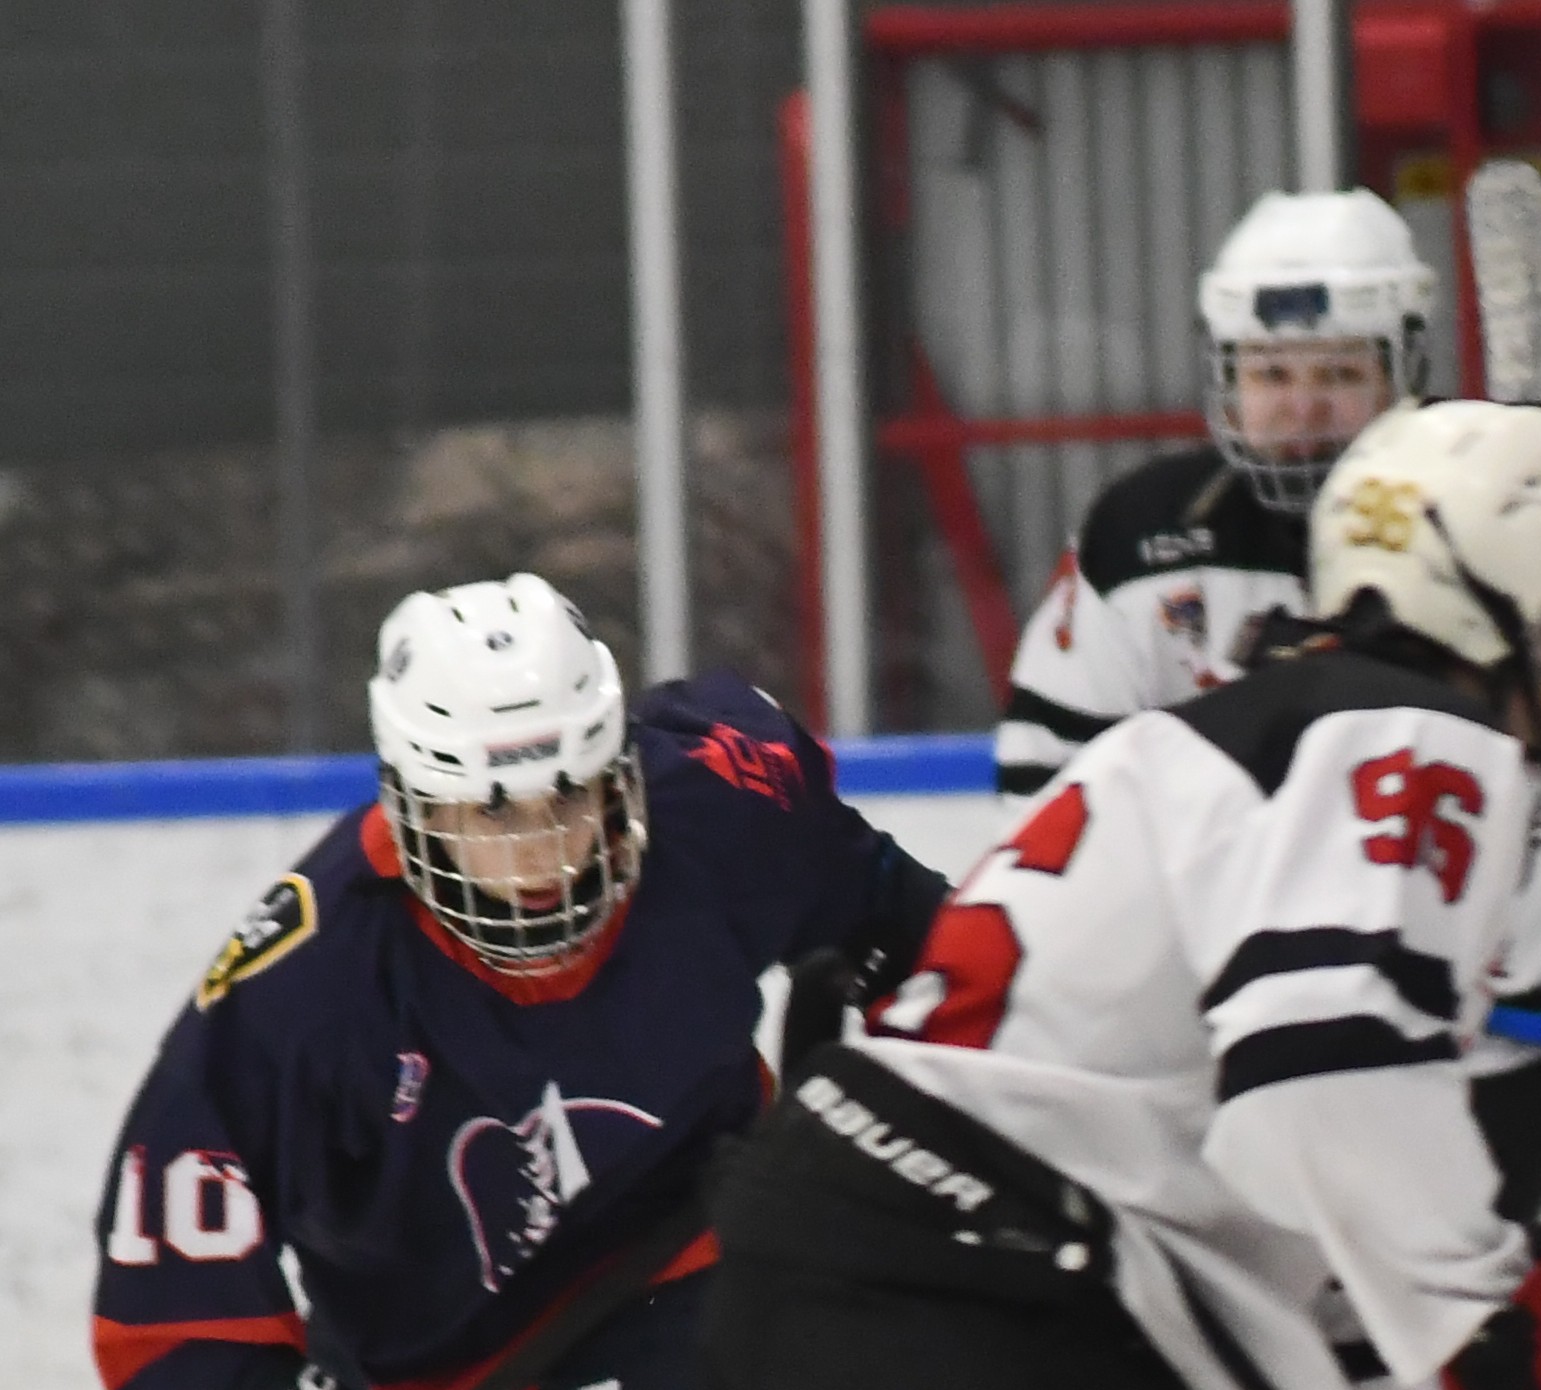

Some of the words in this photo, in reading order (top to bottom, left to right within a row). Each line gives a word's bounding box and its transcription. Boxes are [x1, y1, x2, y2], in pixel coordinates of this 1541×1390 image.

[1352, 747, 1486, 904] 96
[107, 1145, 264, 1266] 10
[796, 1075, 994, 1211] BAUER
